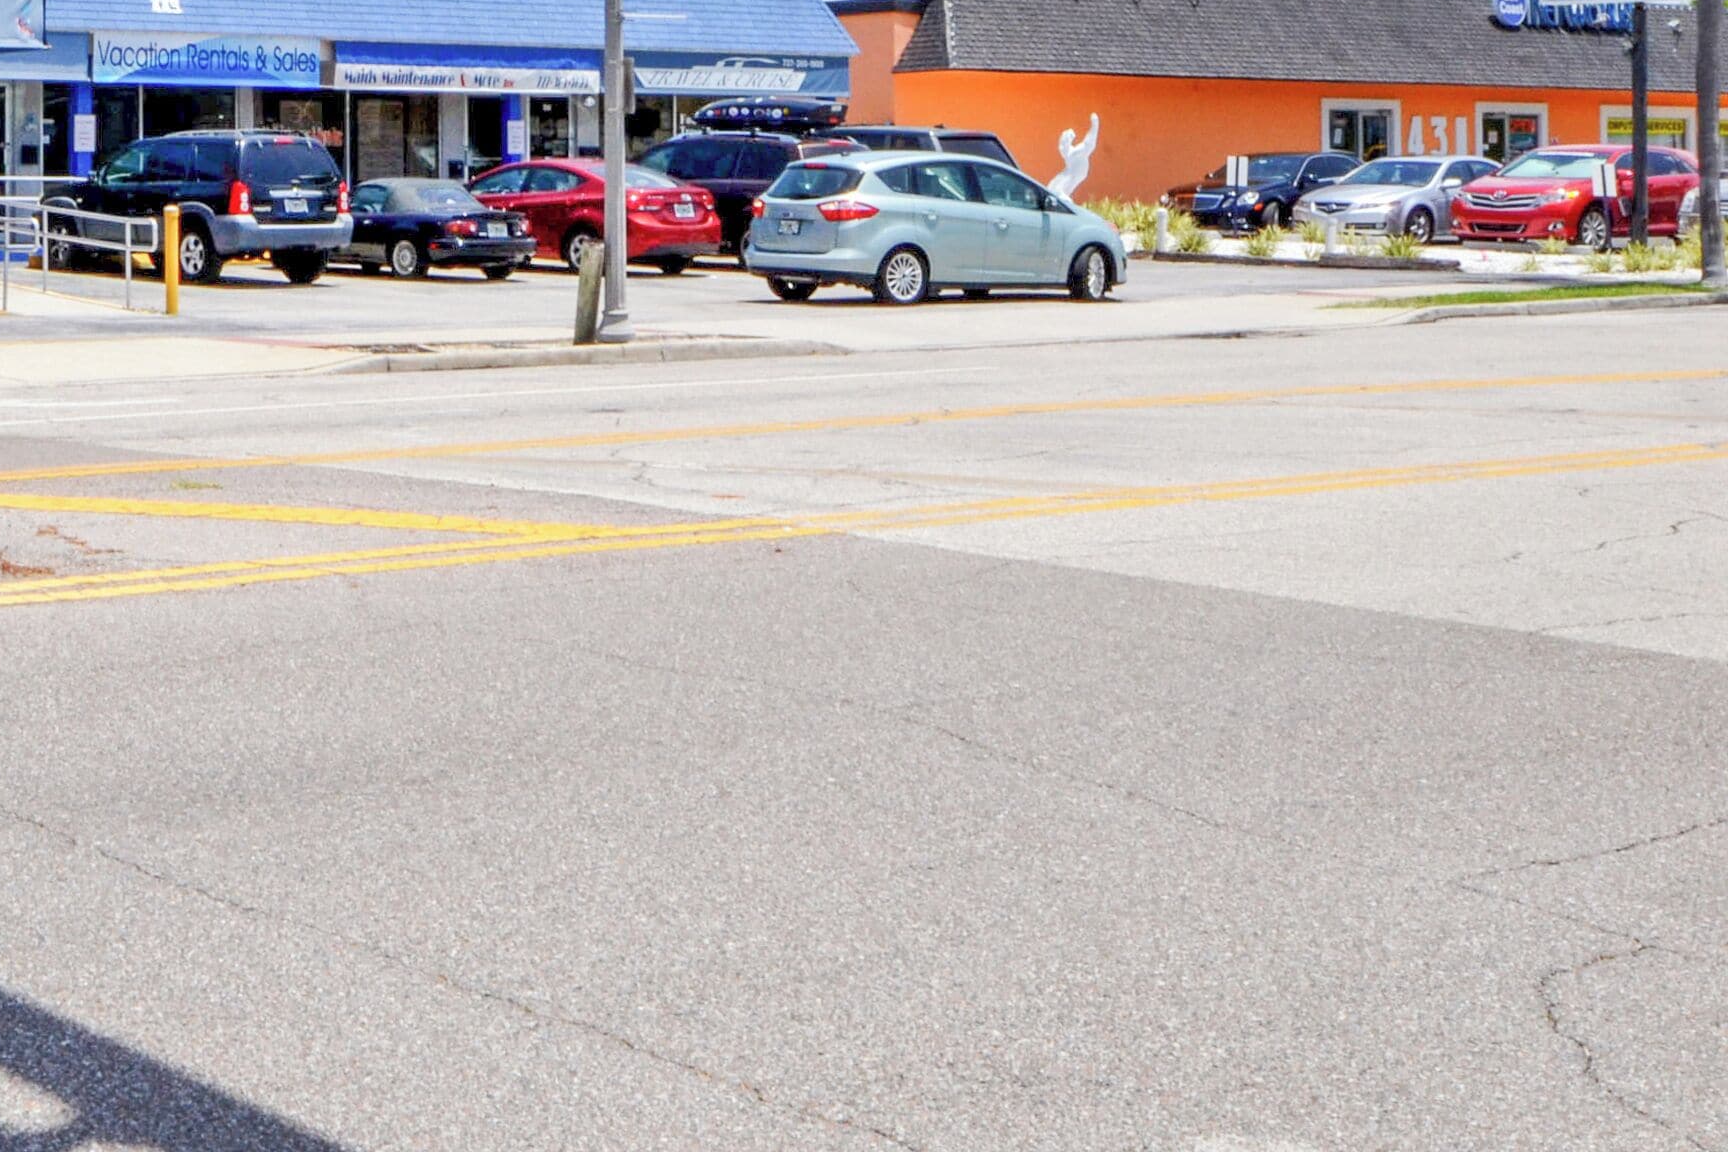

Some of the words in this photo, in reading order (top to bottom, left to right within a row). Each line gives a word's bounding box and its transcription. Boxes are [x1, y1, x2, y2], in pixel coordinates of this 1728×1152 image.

[97, 39, 181, 70] Vacation
[186, 43, 249, 72] Rentals
[255, 44, 267, 71] &
[273, 45, 317, 73] Sales
[381, 69, 455, 87] Maintenance
[1408, 115, 1468, 156] 431
